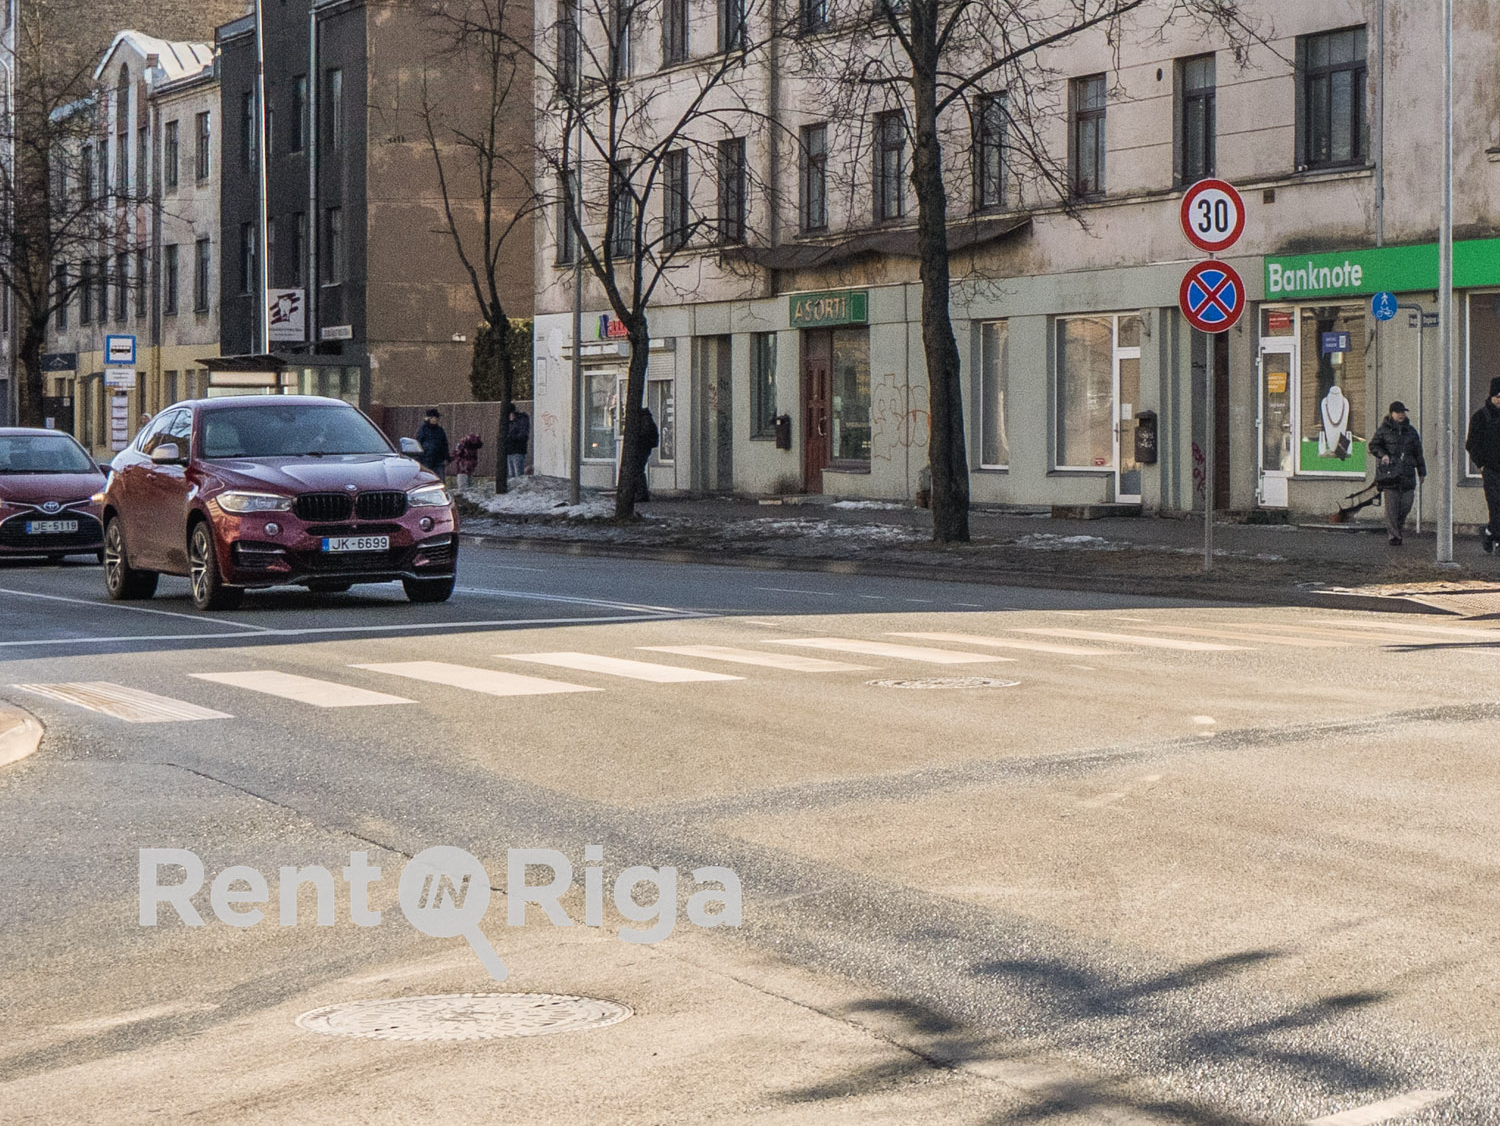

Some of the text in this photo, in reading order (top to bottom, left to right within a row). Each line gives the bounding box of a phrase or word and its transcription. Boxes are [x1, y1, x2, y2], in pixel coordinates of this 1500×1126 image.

[1197, 199, 1229, 233] 30
[1268, 260, 1363, 292] Banknote
[793, 297, 846, 321] ASORTI
[33, 521, 78, 531] JE-5119
[332, 537, 388, 550] JK-6699
